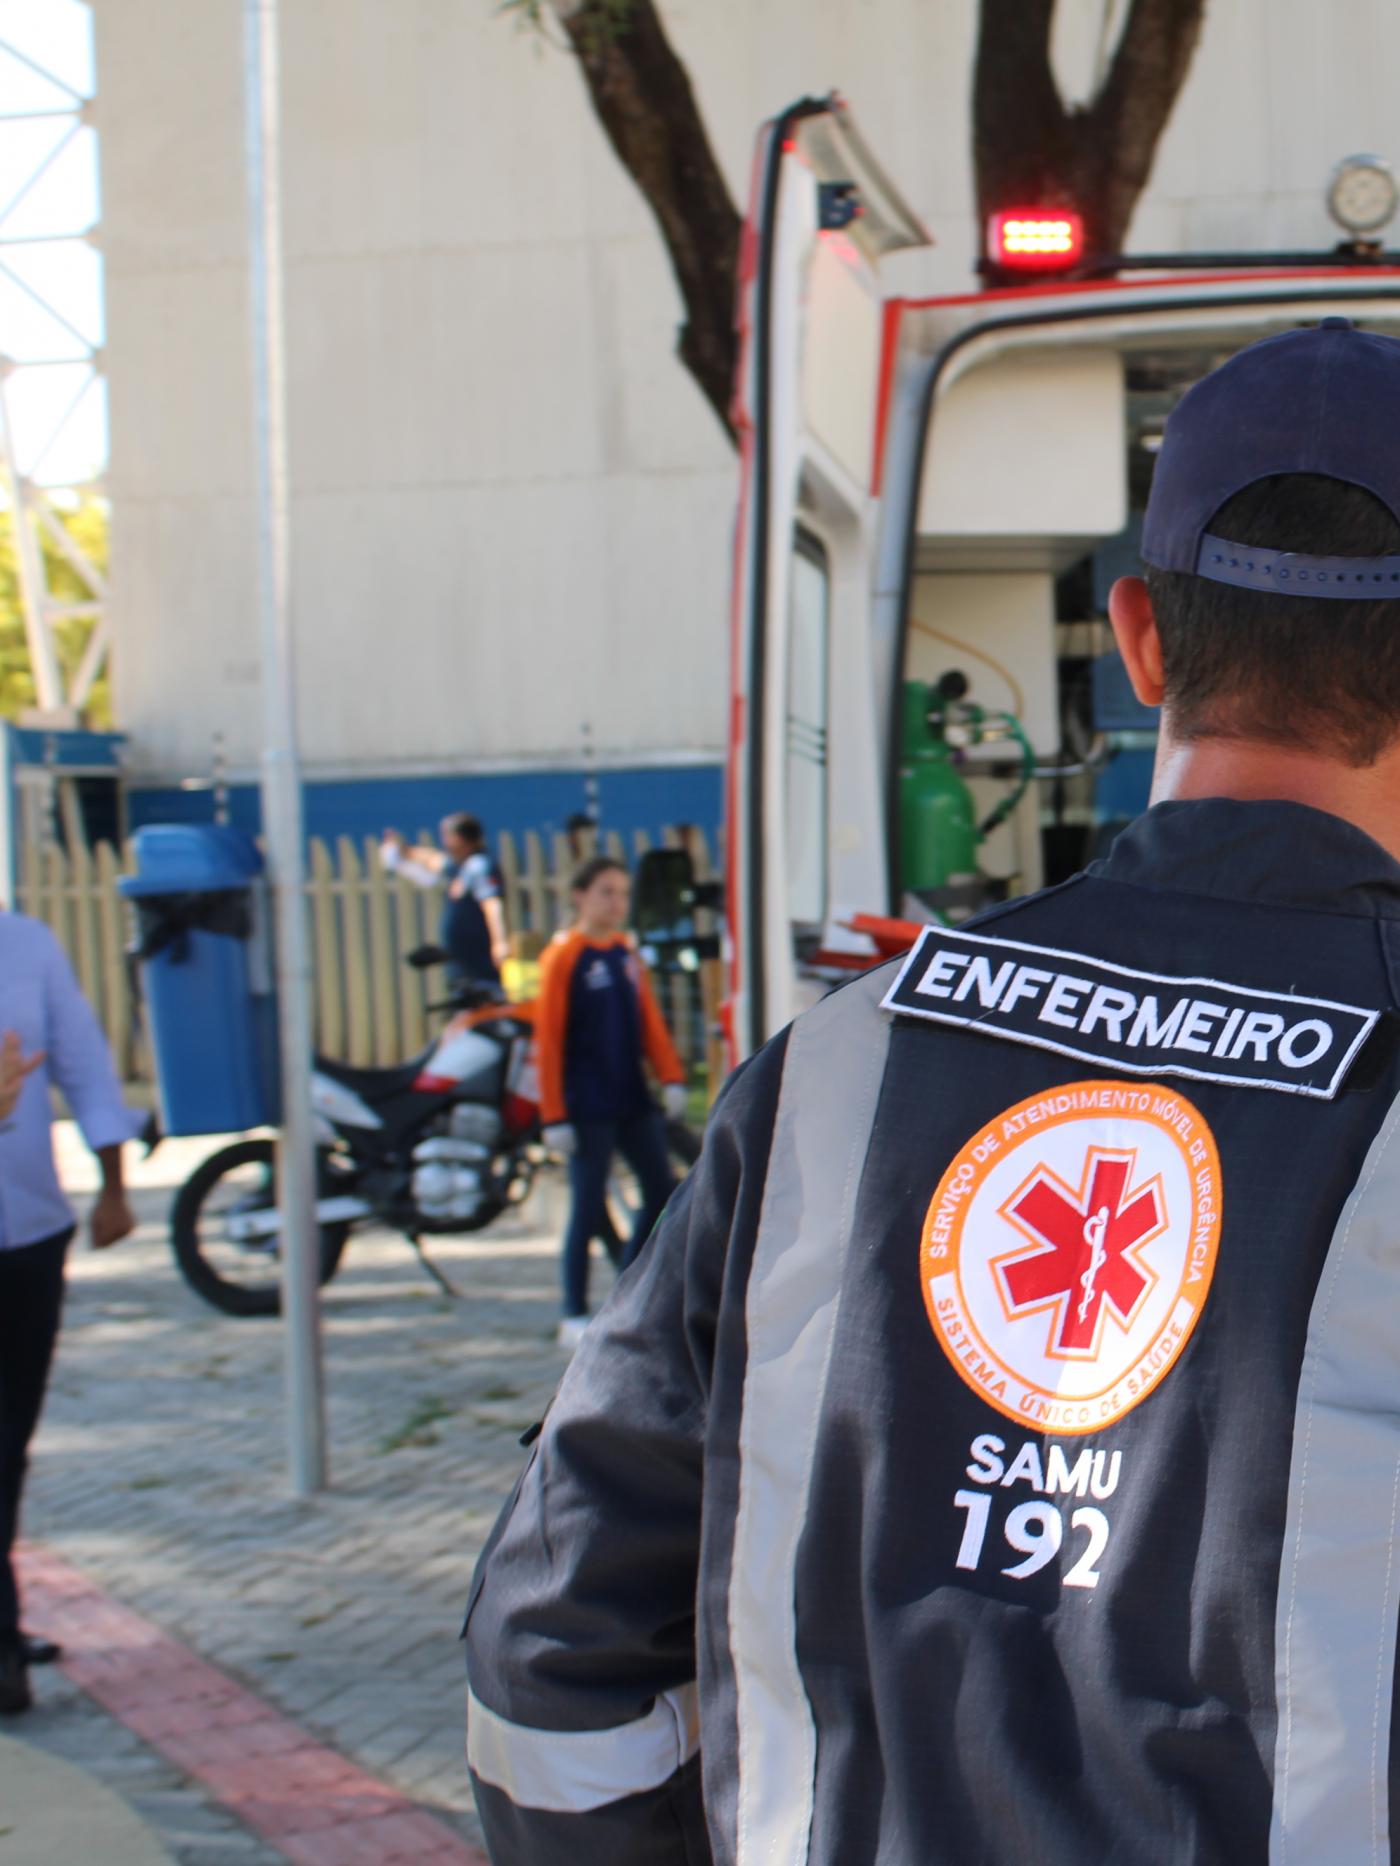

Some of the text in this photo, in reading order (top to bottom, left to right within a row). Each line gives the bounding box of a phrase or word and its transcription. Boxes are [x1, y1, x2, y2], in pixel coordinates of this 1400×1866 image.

[915, 951, 1334, 1068] ENFERMEIRO
[930, 1090, 1216, 1282] SERVIÇO DE ATENDIMENTO MÓVEL DE URGÊNCIA
[937, 1297, 1183, 1423] SISTEMA ÚNICO DE SAÚDE
[965, 1433, 1123, 1500] SAMU
[954, 1489, 1109, 1588] 192
